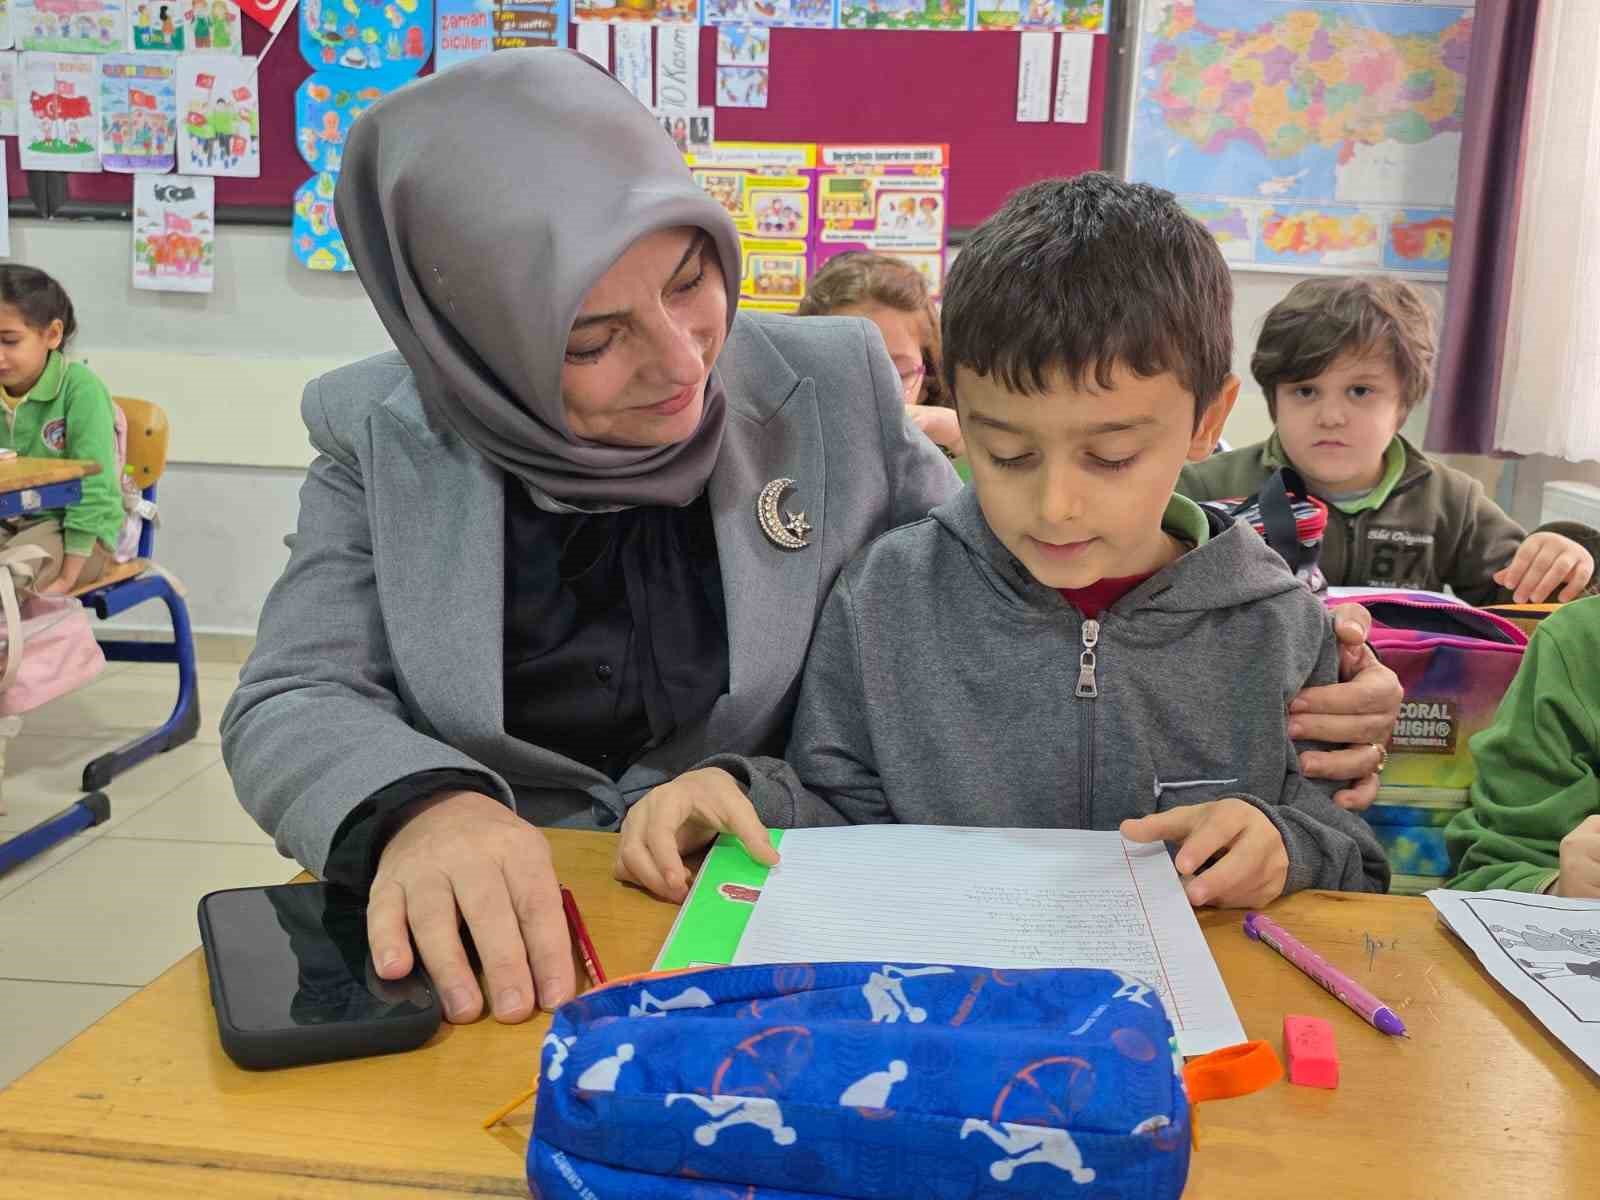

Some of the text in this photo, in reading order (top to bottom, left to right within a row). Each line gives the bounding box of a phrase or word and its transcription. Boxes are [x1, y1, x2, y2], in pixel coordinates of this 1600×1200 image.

[442, 12, 486, 32] zaman
[661, 85, 688, 112] 10
[1398, 703, 1451, 720] CORAL
